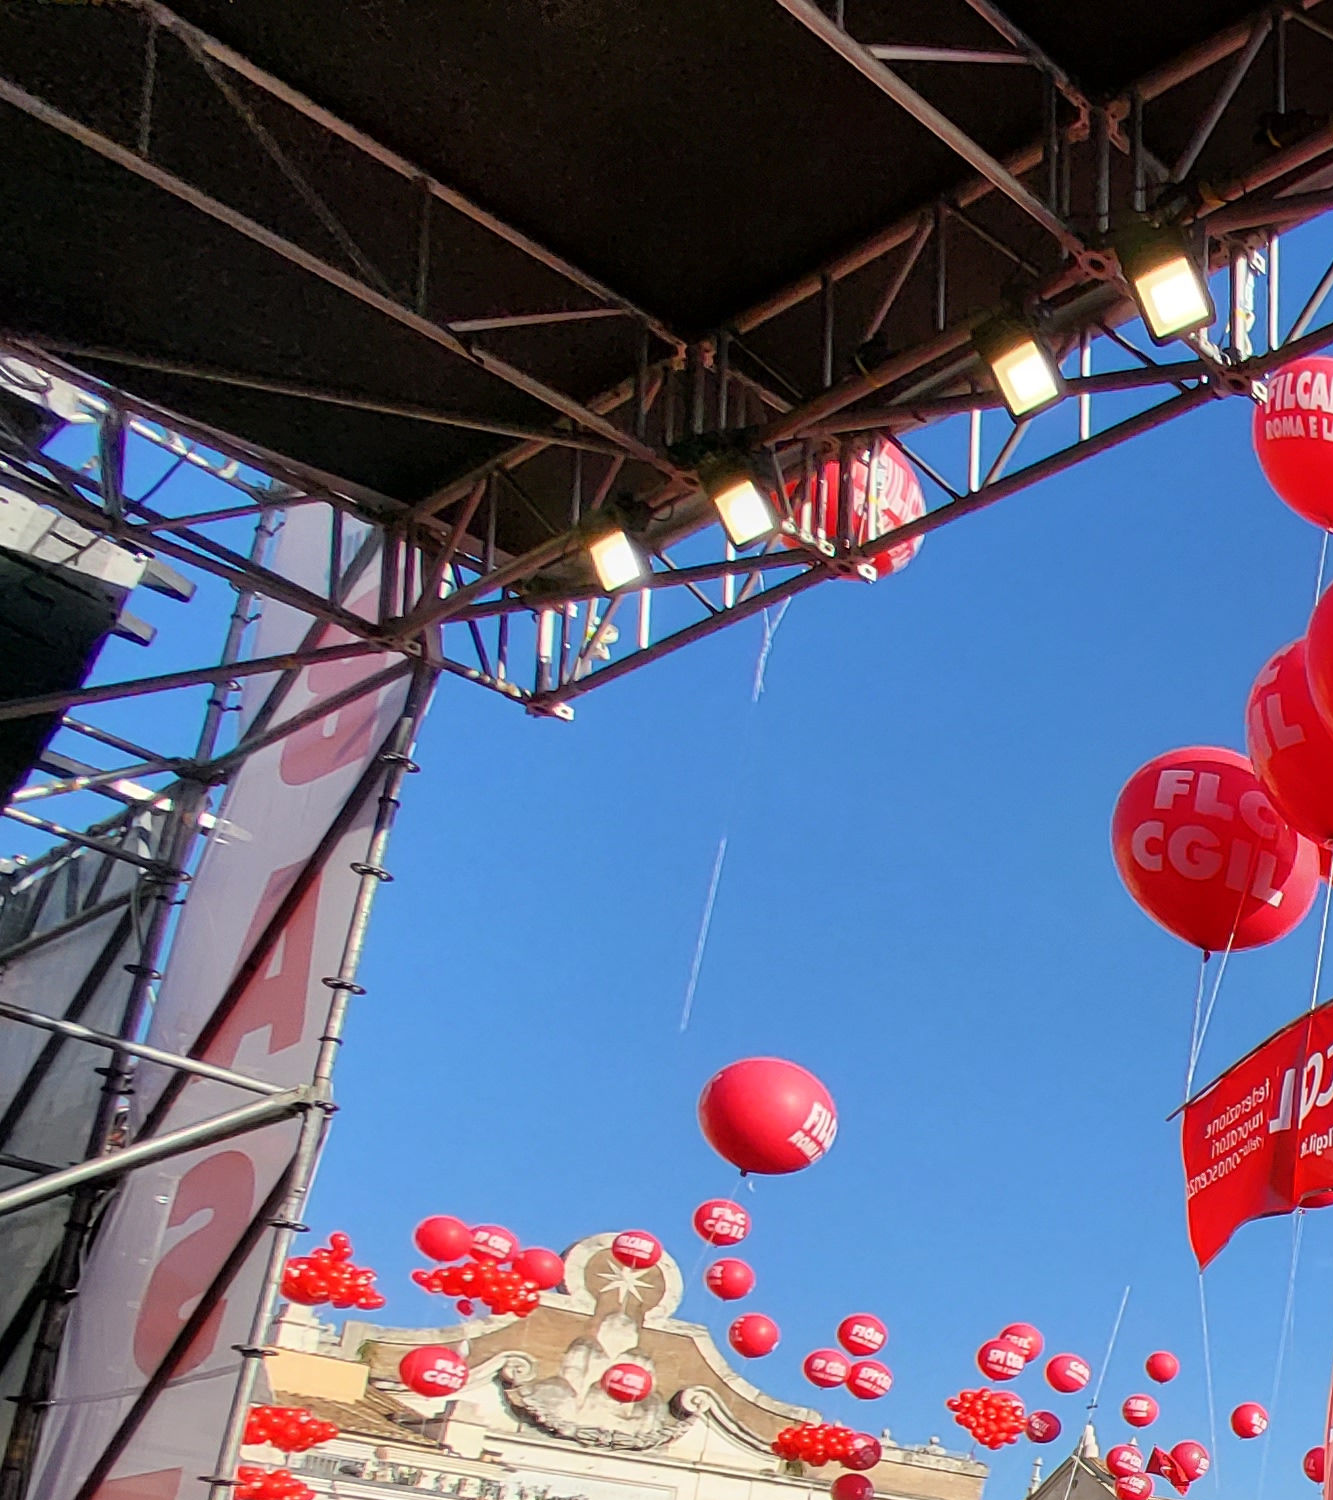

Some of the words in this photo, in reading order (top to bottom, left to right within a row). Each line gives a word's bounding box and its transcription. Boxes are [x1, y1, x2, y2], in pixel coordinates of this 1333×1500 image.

[1265, 413, 1306, 440] ROMA
[1308, 416, 1319, 440] E
[1155, 768, 1289, 838] FLC
[1132, 819, 1284, 907] CGIL
[703, 1219, 745, 1240] CGIL
